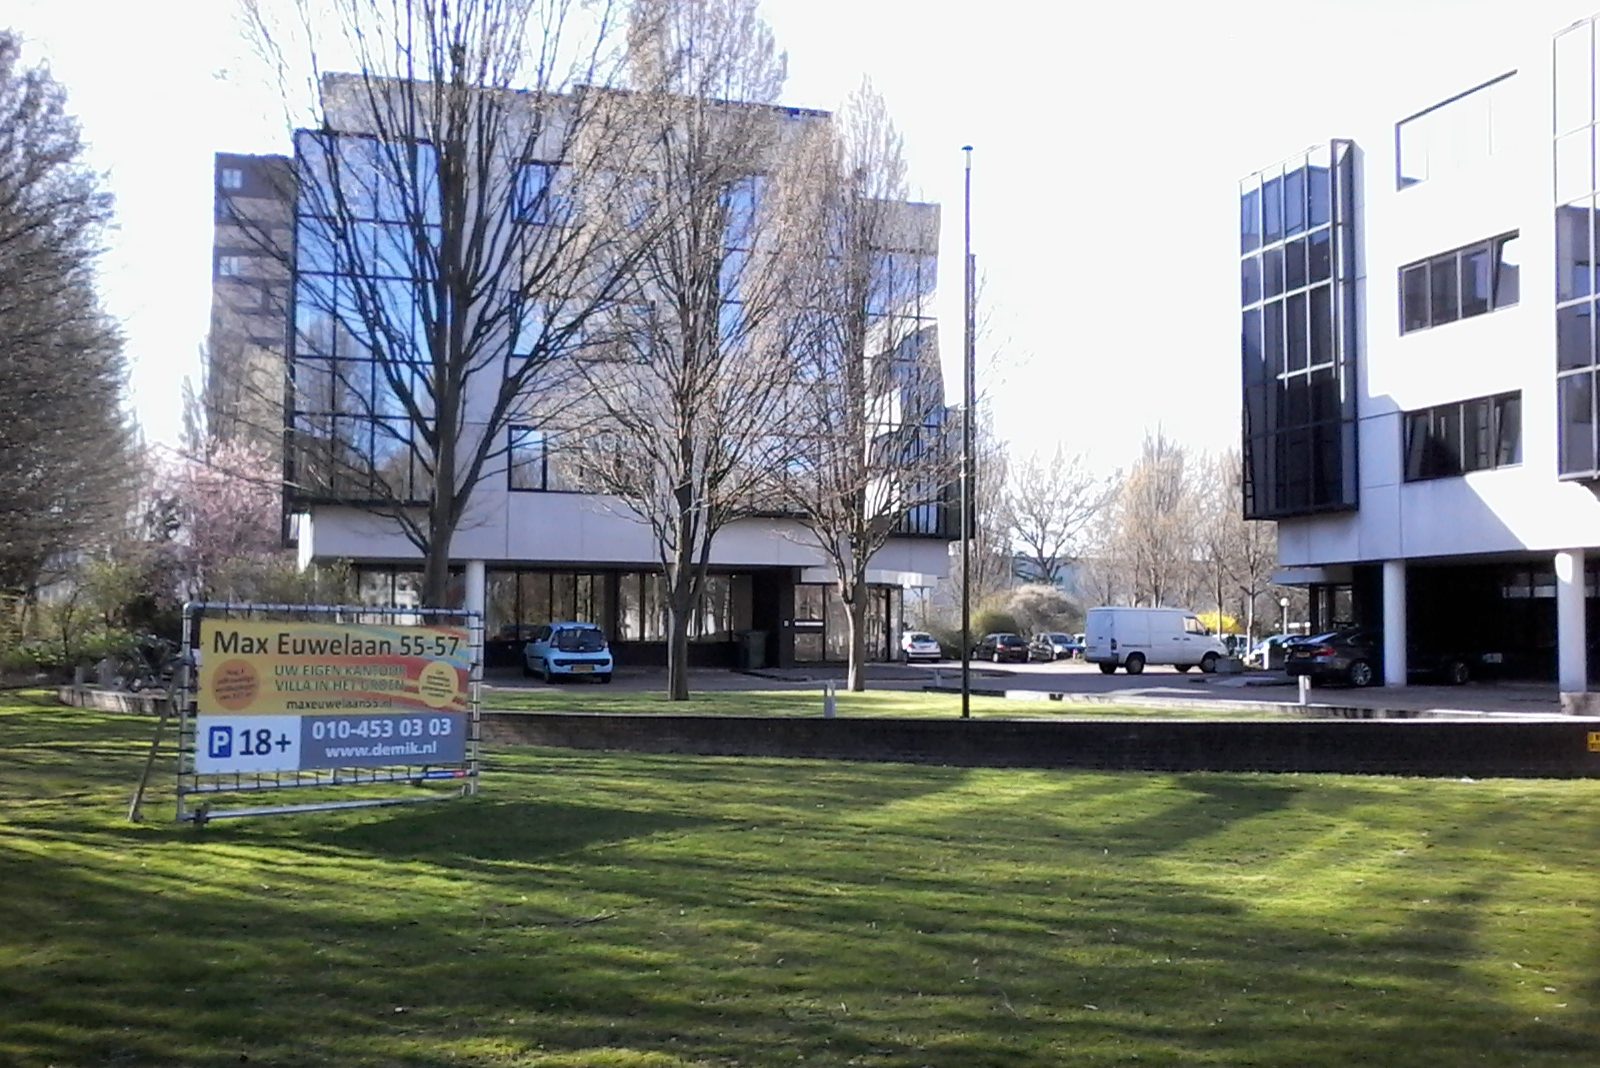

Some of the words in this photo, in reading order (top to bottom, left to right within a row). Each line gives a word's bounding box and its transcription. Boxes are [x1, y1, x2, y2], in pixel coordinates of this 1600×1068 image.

[213, 631, 269, 655] Max
[278, 633, 391, 656] Euwelaan
[400, 635, 460, 656] 55-57
[275, 665, 298, 676] UW
[303, 665, 340, 676] EIGEN
[275, 680, 311, 691] VILLA
[315, 680, 328, 691] IN
[312, 720, 394, 740] 010-453
[400, 719, 422, 737] 03
[429, 718, 452, 736] 03
[239, 729, 292, 756] 18+
[325, 740, 437, 758] www.demik.nl
